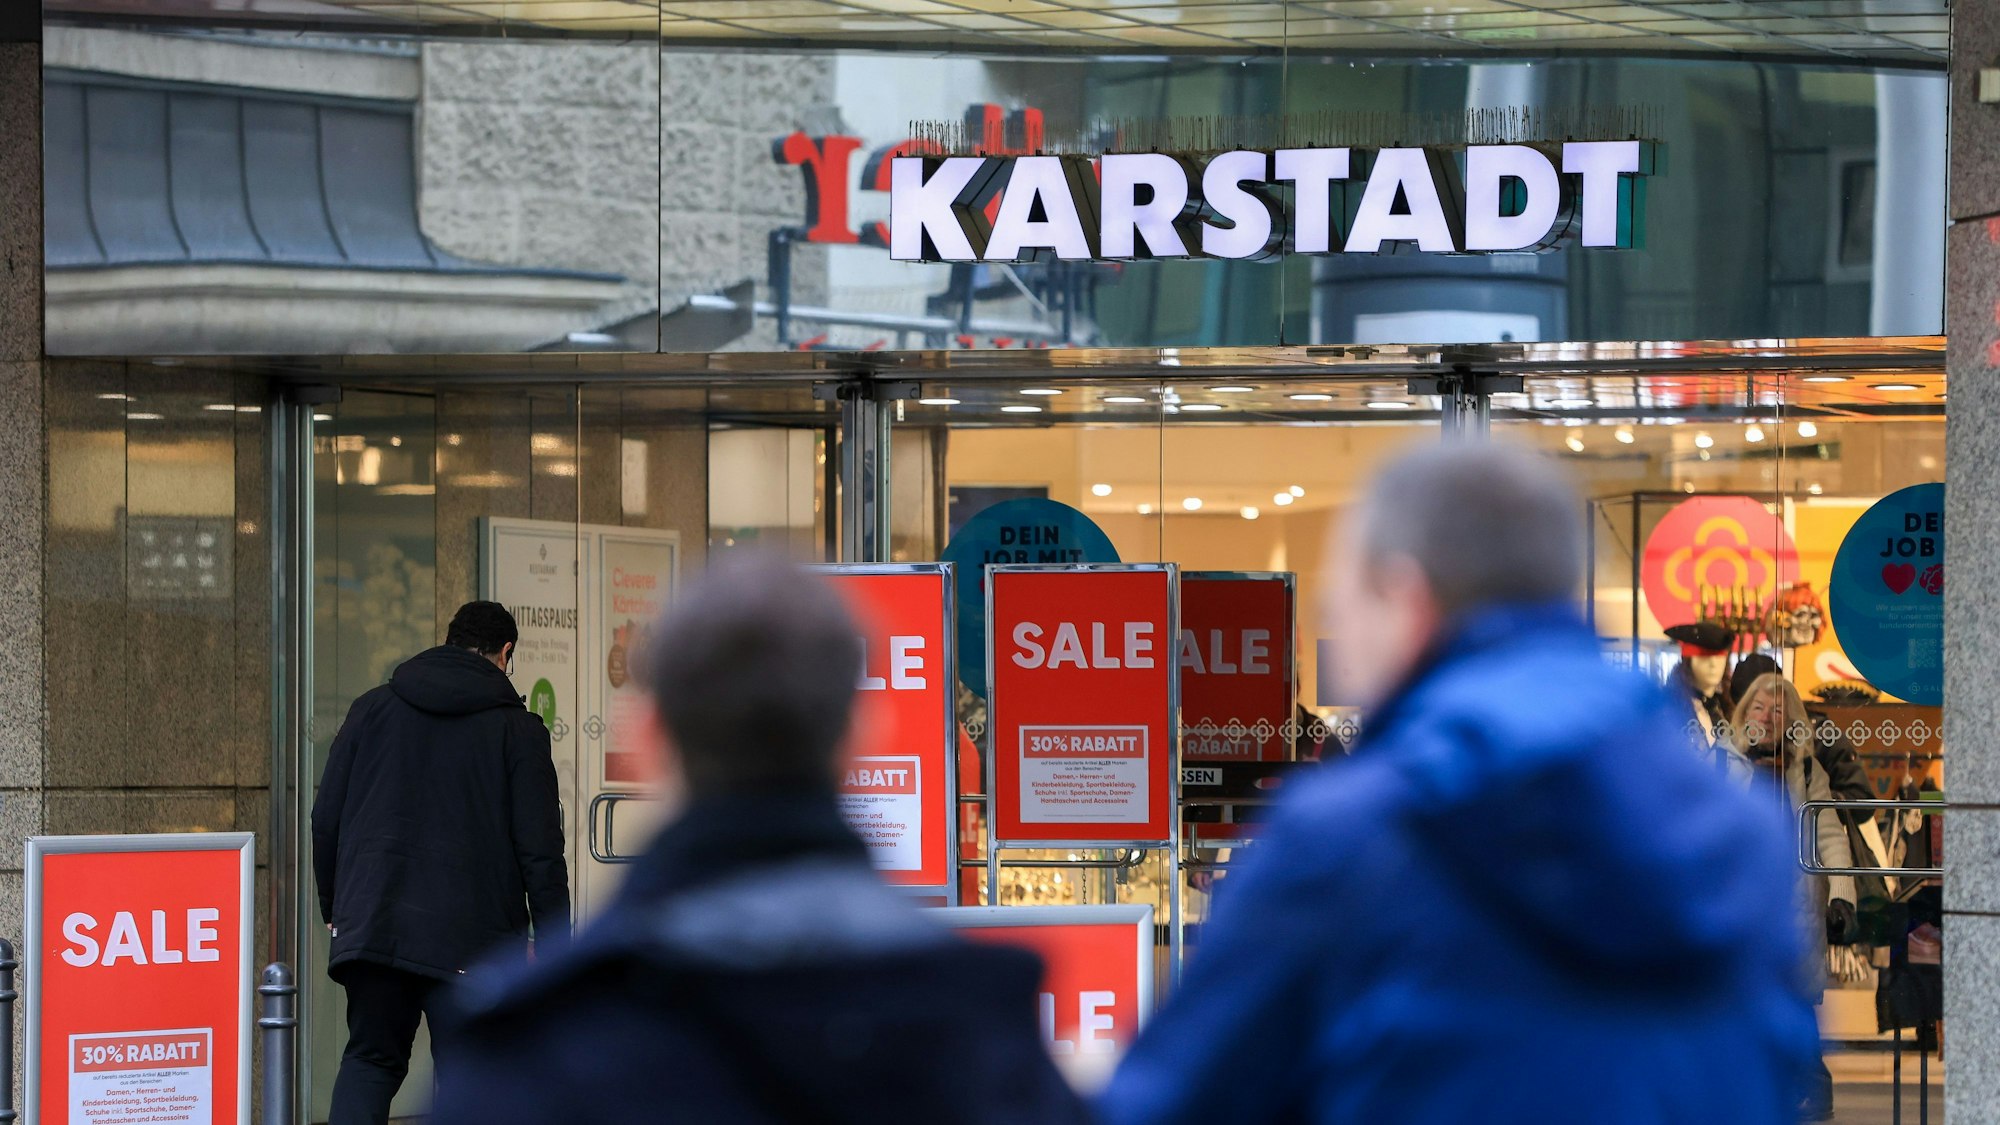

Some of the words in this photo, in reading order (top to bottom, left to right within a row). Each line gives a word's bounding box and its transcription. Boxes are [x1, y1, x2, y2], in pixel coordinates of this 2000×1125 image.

[890, 140, 1640, 261] KARSTADT
[1904, 512, 1944, 532] DE
[1000, 526, 1059, 545] DEIN
[1039, 549, 1082, 563] MIT
[1880, 537, 1935, 558] JOB
[612, 567, 657, 589] Cleveres
[1011, 621, 1155, 669] SALE
[1180, 629, 1270, 674] ALE
[856, 636, 927, 690] LE
[1070, 736, 1137, 751] RABATT
[1187, 740, 1250, 755] RABATT
[843, 769, 908, 787] ABATT
[1181, 771, 1215, 783] SSEN
[61, 908, 220, 967] SALE
[1039, 991, 1116, 1054] LE
[127, 1042, 200, 1062] RABATT
[136, 1087, 161, 1095] Herren-
[82, 1097, 142, 1107] Kinderbekleidung,
[143, 1095, 199, 1104] Sportbekleidung,
[125, 1106, 168, 1115] Sportschuhe,
[92, 1117, 135, 1125] Handtaschen
[151, 1114, 189, 1122] Accessoires
